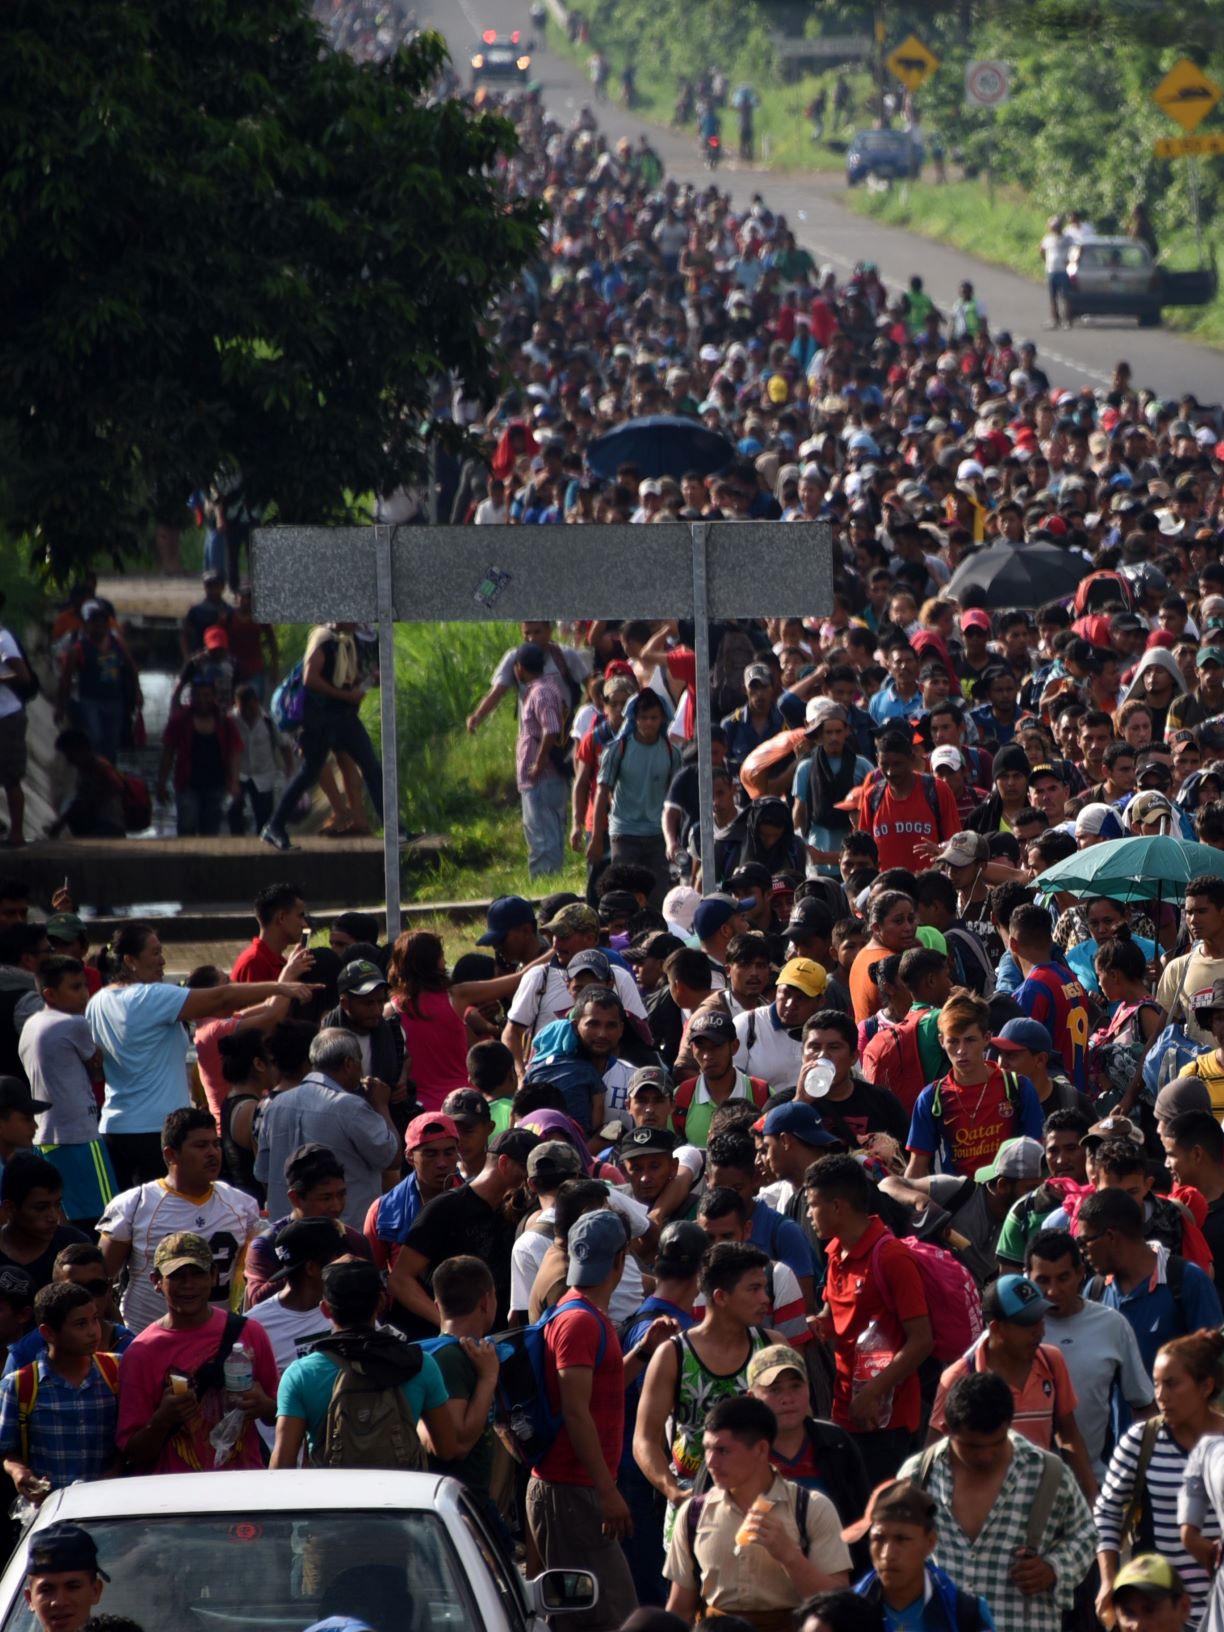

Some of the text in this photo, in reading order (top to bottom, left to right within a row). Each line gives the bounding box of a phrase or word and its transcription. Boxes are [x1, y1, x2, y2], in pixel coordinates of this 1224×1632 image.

[895, 822, 932, 835] DOGS
[955, 1122, 1004, 1146] Qatar
[951, 1138, 1001, 1161] Foundati
